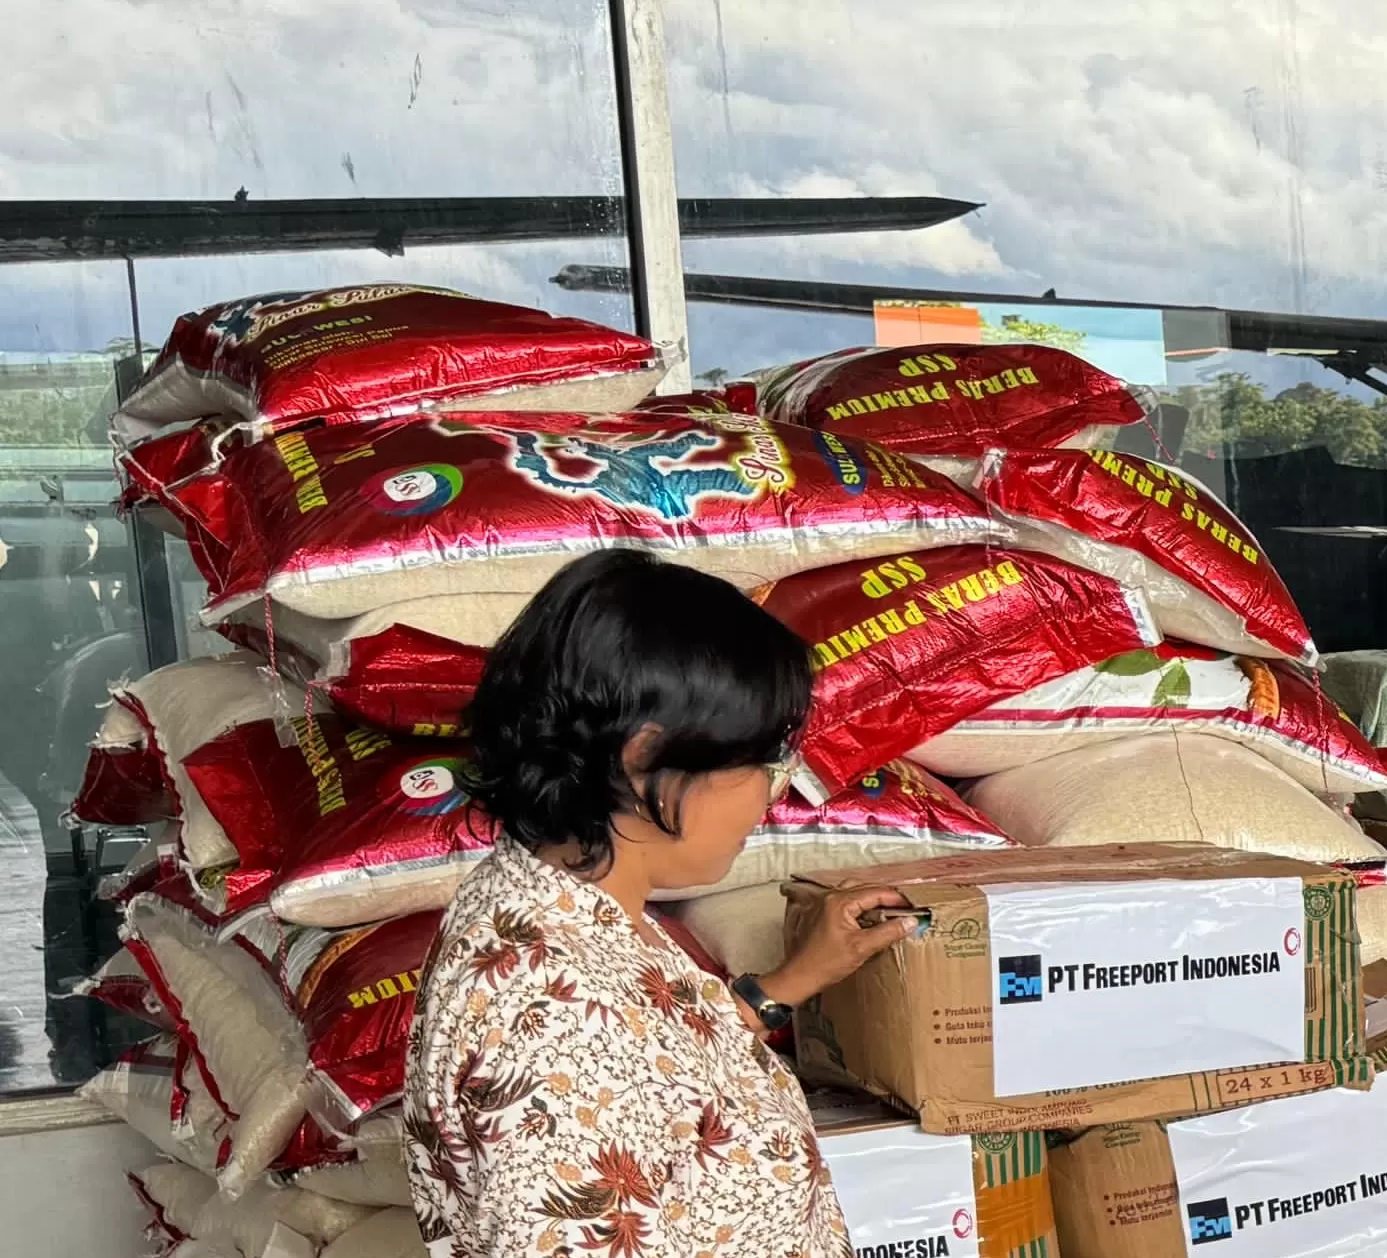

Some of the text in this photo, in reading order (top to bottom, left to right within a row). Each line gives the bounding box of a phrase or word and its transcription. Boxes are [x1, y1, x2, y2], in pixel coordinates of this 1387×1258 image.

[898, 354, 958, 376] SSP
[827, 367, 1039, 420] BERAS PREMIUM
[1181, 502, 1259, 564] BERAS
[861, 556, 926, 600] SSP
[928, 561, 1023, 614] BERAS
[1048, 952, 1280, 993] PT FREEPORT INDONESIA
[1225, 1076, 1253, 1094] 24
[1279, 1071, 1289, 1087] 1
[1300, 1065, 1327, 1088] kg
[966, 1108, 1005, 1122] SWEET
[1234, 1202, 1264, 1230] PT
[1268, 1180, 1357, 1220] FREEPORT
